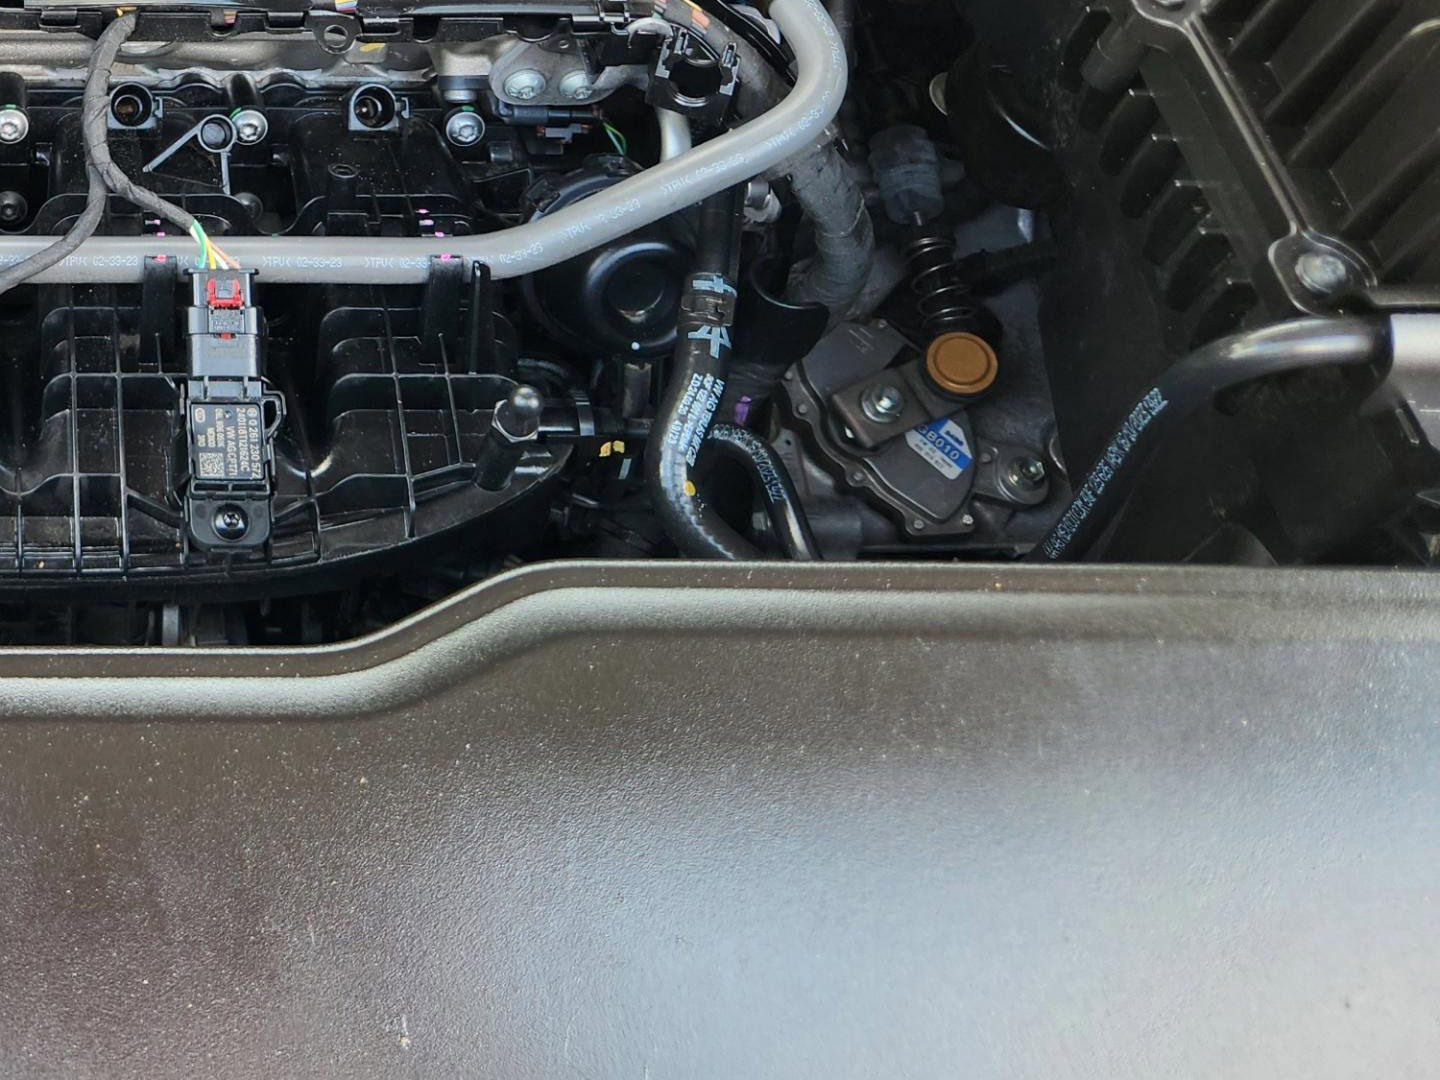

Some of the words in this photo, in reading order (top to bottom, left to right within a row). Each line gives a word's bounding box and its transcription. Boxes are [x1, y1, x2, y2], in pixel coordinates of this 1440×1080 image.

[226, 425, 236, 440] VW
[248, 426, 258, 442] 261
[227, 440, 237, 452] AG
[249, 444, 260, 460] 230
[251, 462, 262, 479] 572
